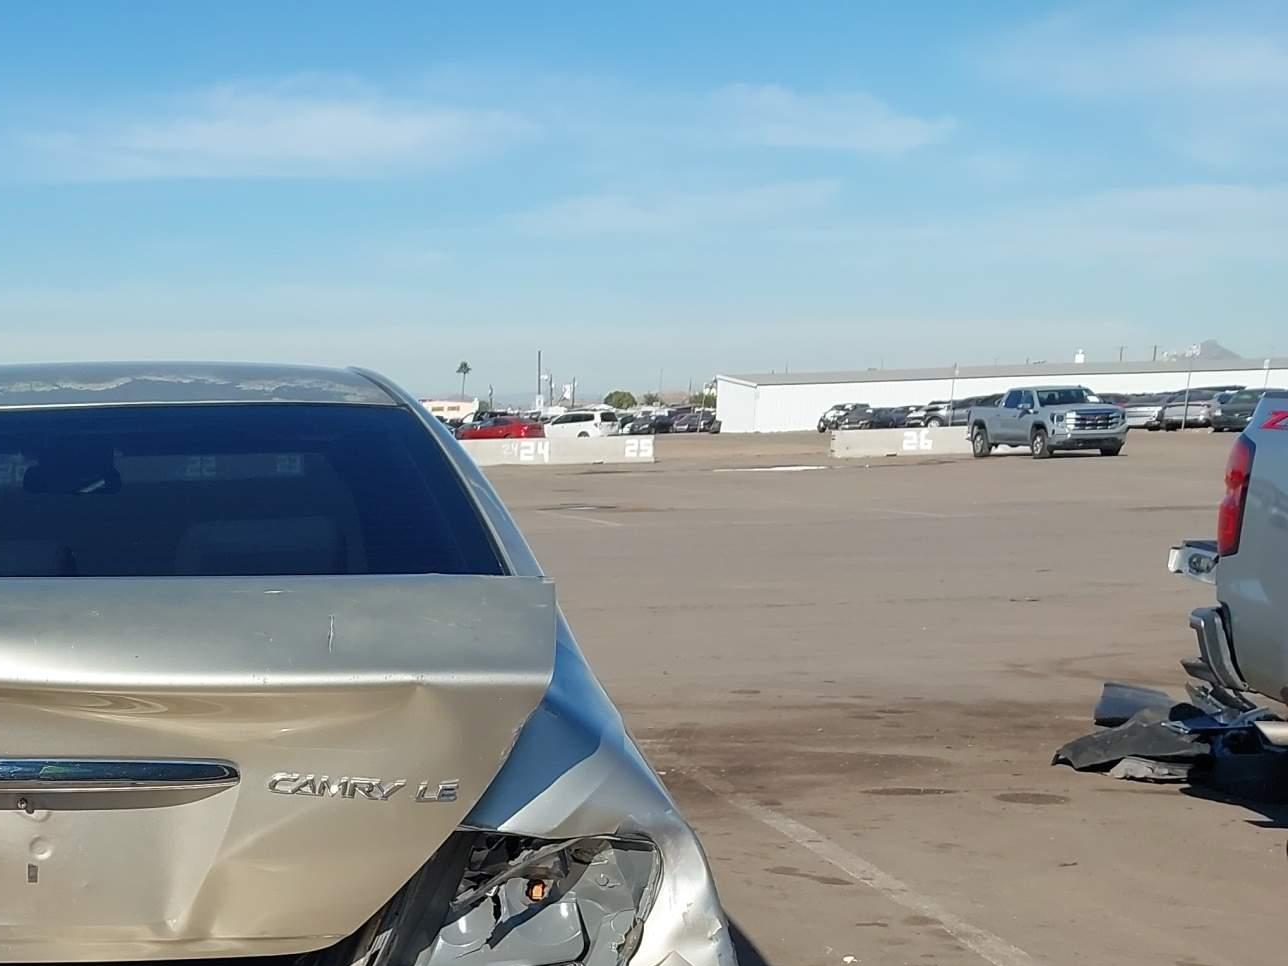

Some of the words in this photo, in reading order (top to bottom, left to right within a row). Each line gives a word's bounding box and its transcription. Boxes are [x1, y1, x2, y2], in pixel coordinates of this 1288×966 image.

[624, 438, 654, 458] 25
[903, 428, 933, 450] 26
[519, 440, 550, 462] 24
[268, 772, 408, 801] CAMRY
[415, 778, 460, 803] LE
